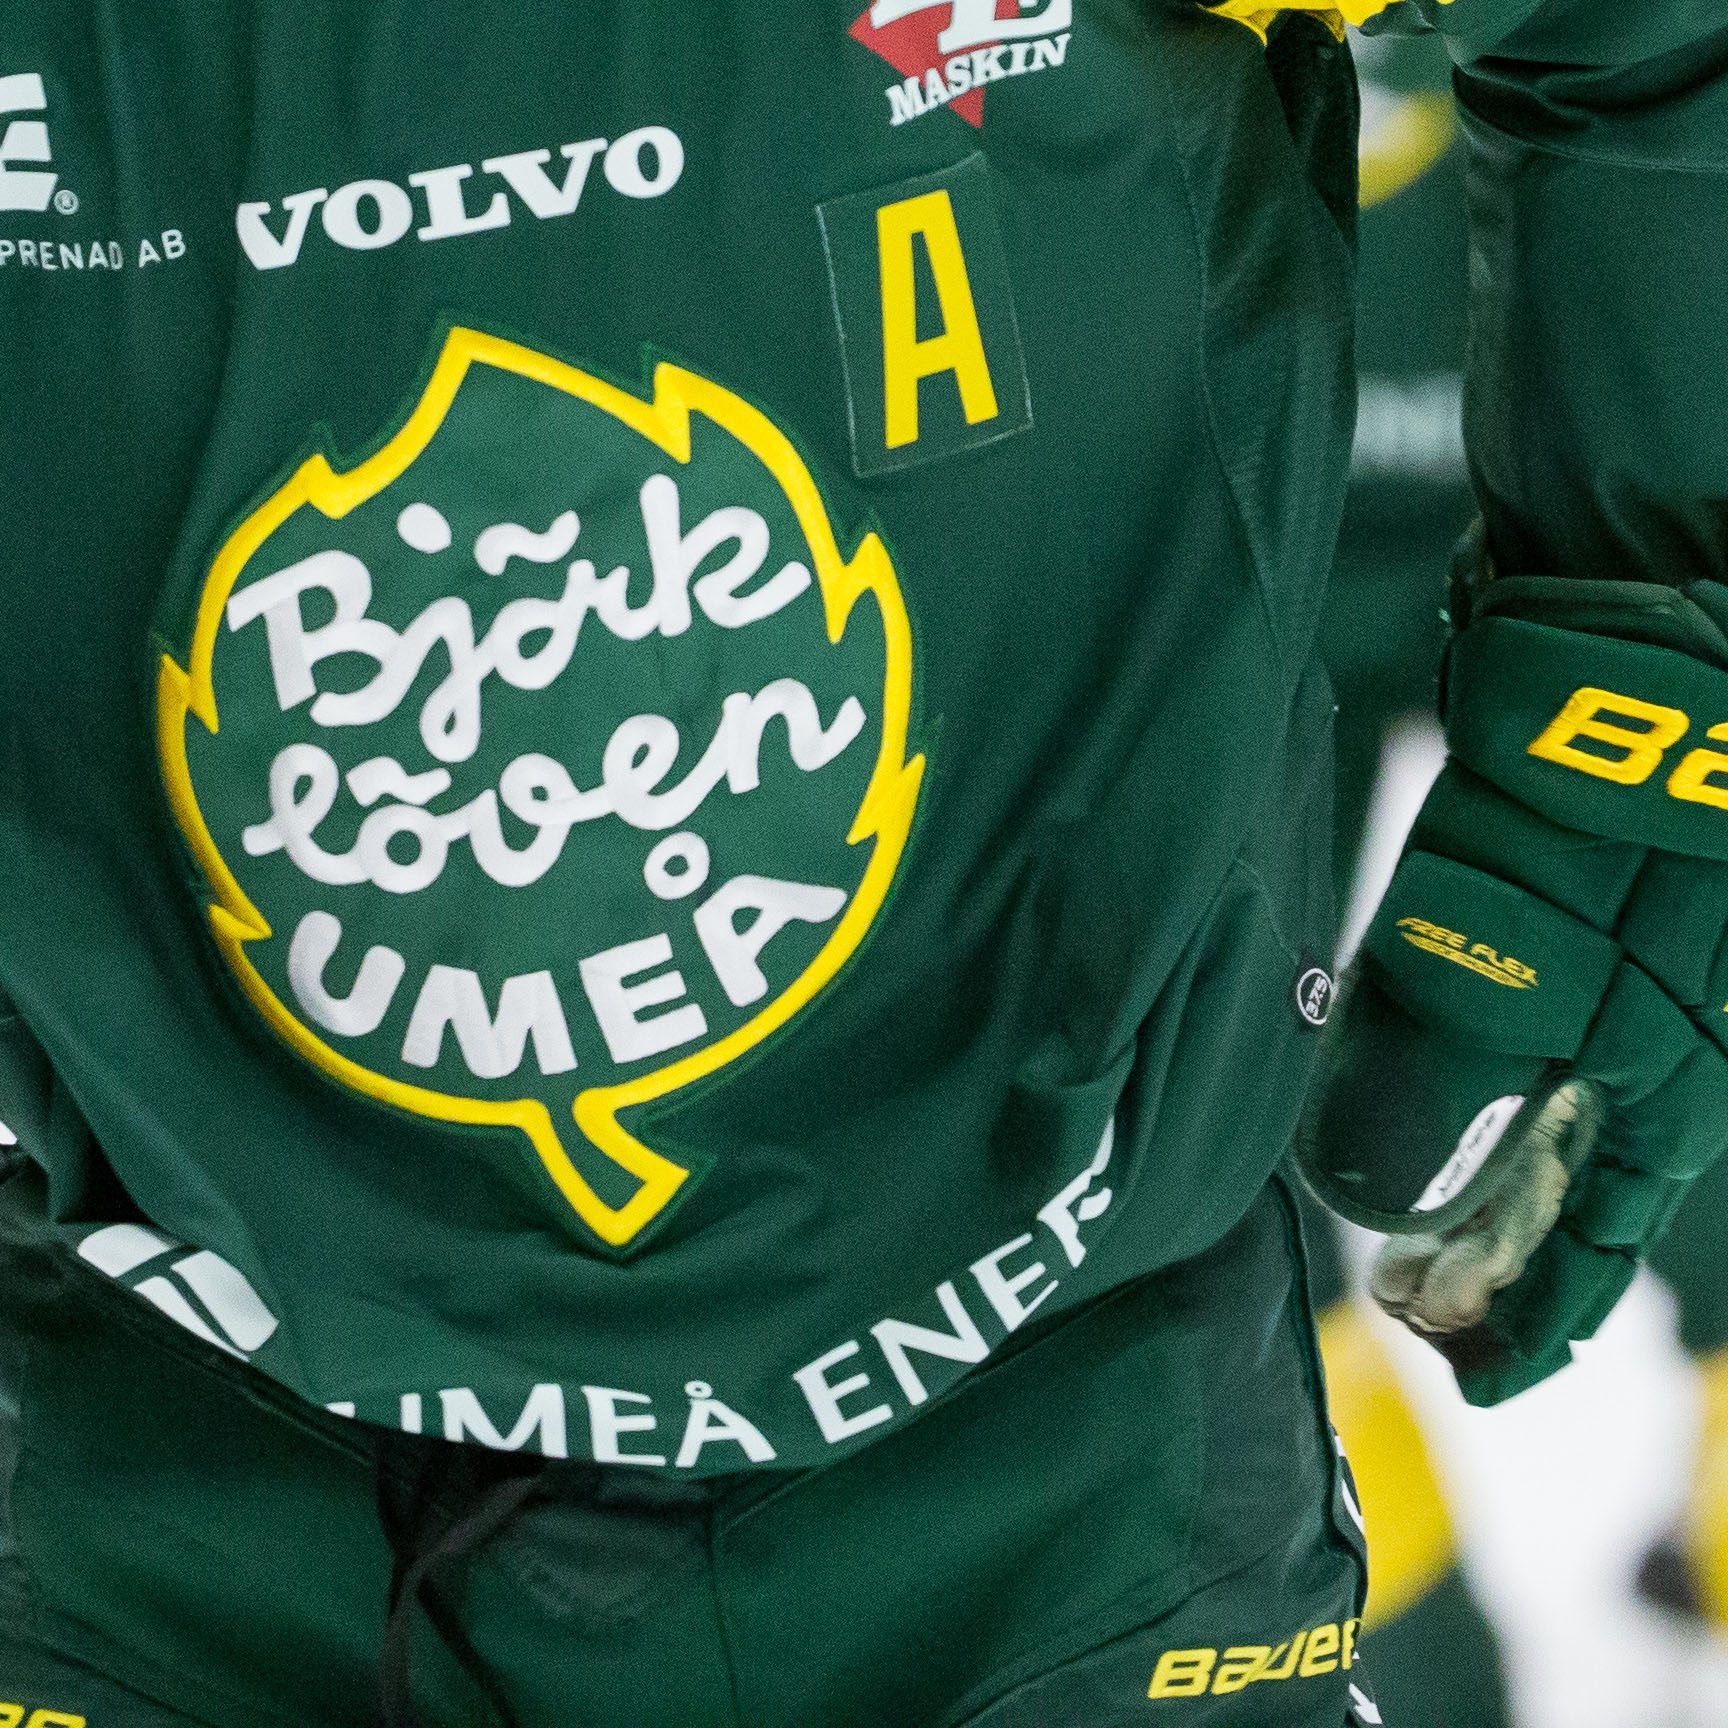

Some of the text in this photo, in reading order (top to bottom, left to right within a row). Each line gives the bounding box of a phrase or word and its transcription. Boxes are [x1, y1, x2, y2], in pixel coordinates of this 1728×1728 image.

[884, 33, 1072, 126] MASKIN
[138, 229, 187, 268] AB
[235, 125, 685, 271] VOLVO
[876, 188, 999, 450] A
[226, 473, 812, 763] Björk
[288, 832, 848, 1080] UMEÅ
